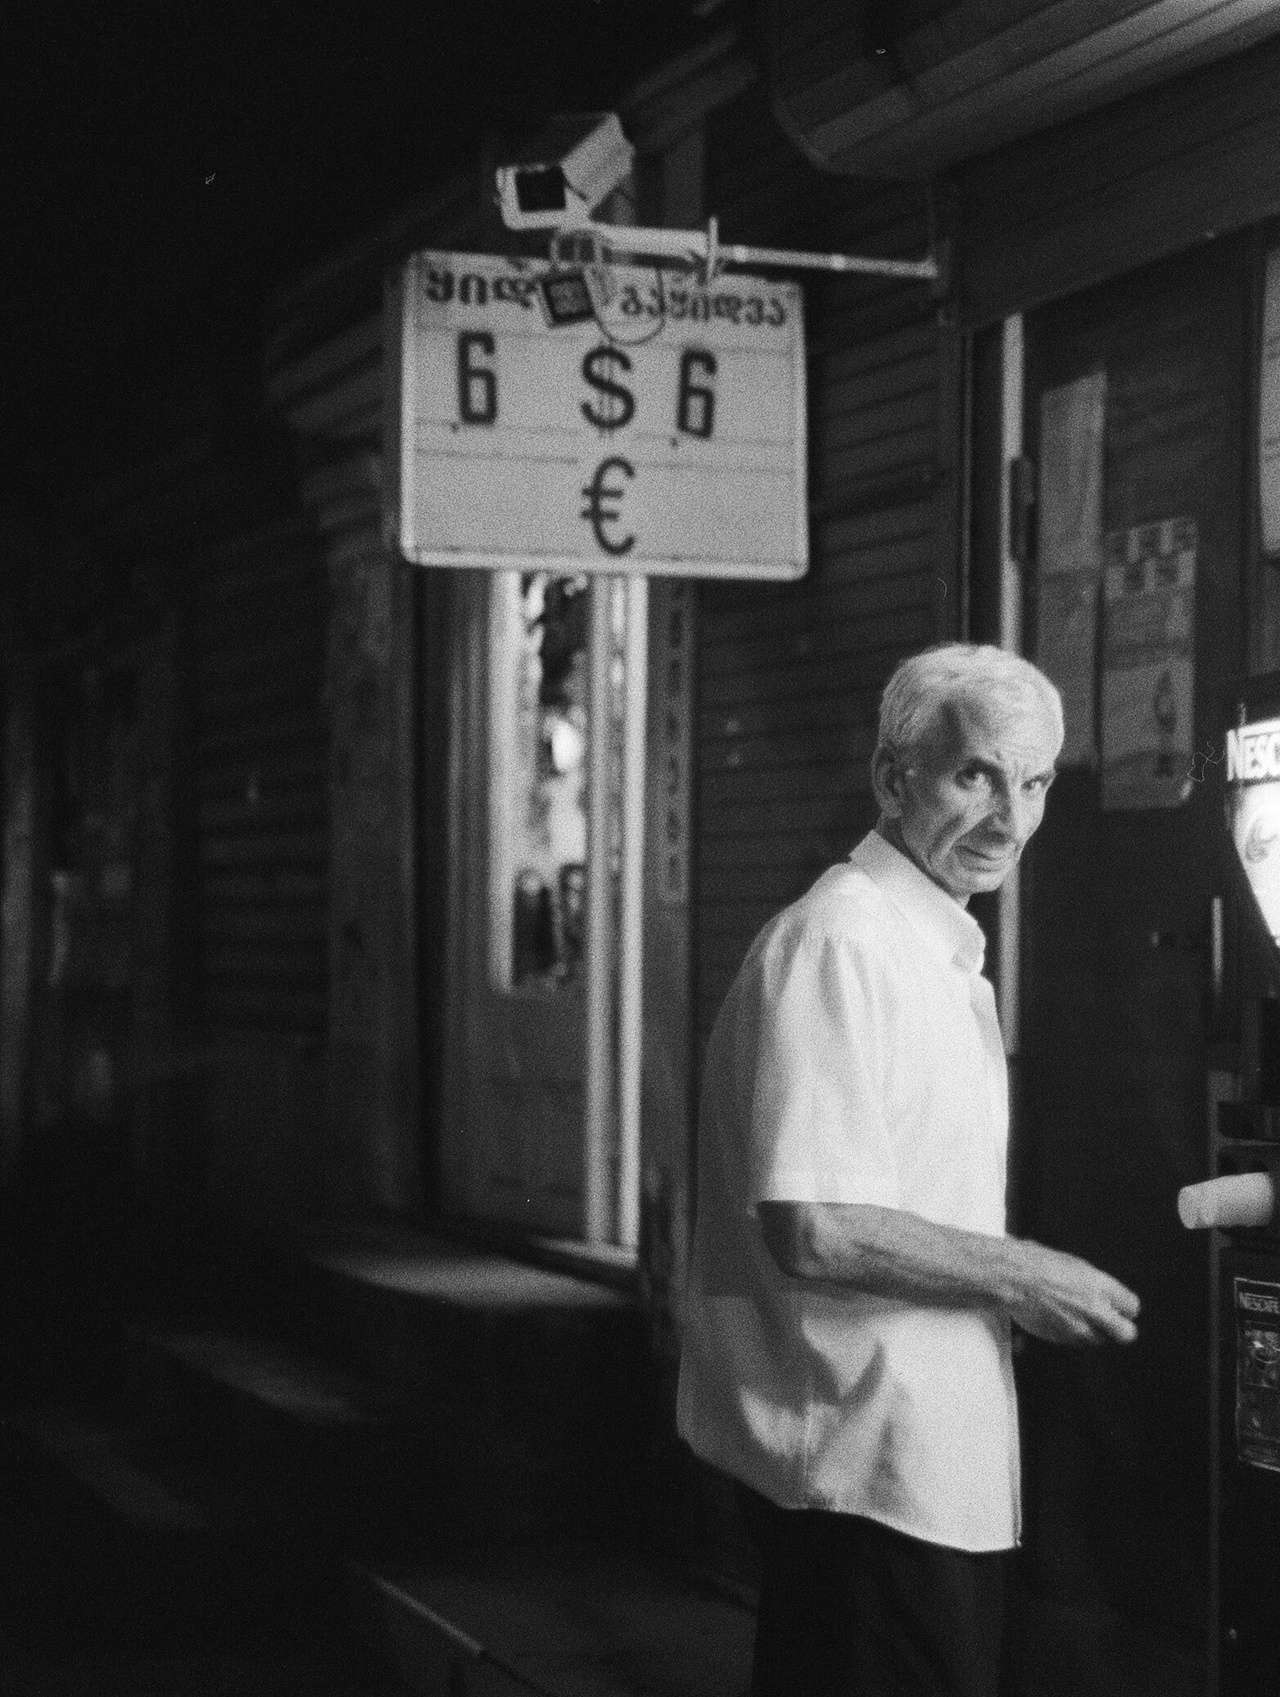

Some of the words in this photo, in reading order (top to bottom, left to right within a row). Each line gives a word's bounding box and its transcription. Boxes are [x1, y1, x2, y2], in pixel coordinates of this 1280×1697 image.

[456, 329, 497, 426] 6
[580, 344, 635, 435] $
[676, 347, 718, 438] 6
[580, 457, 635, 556] €
